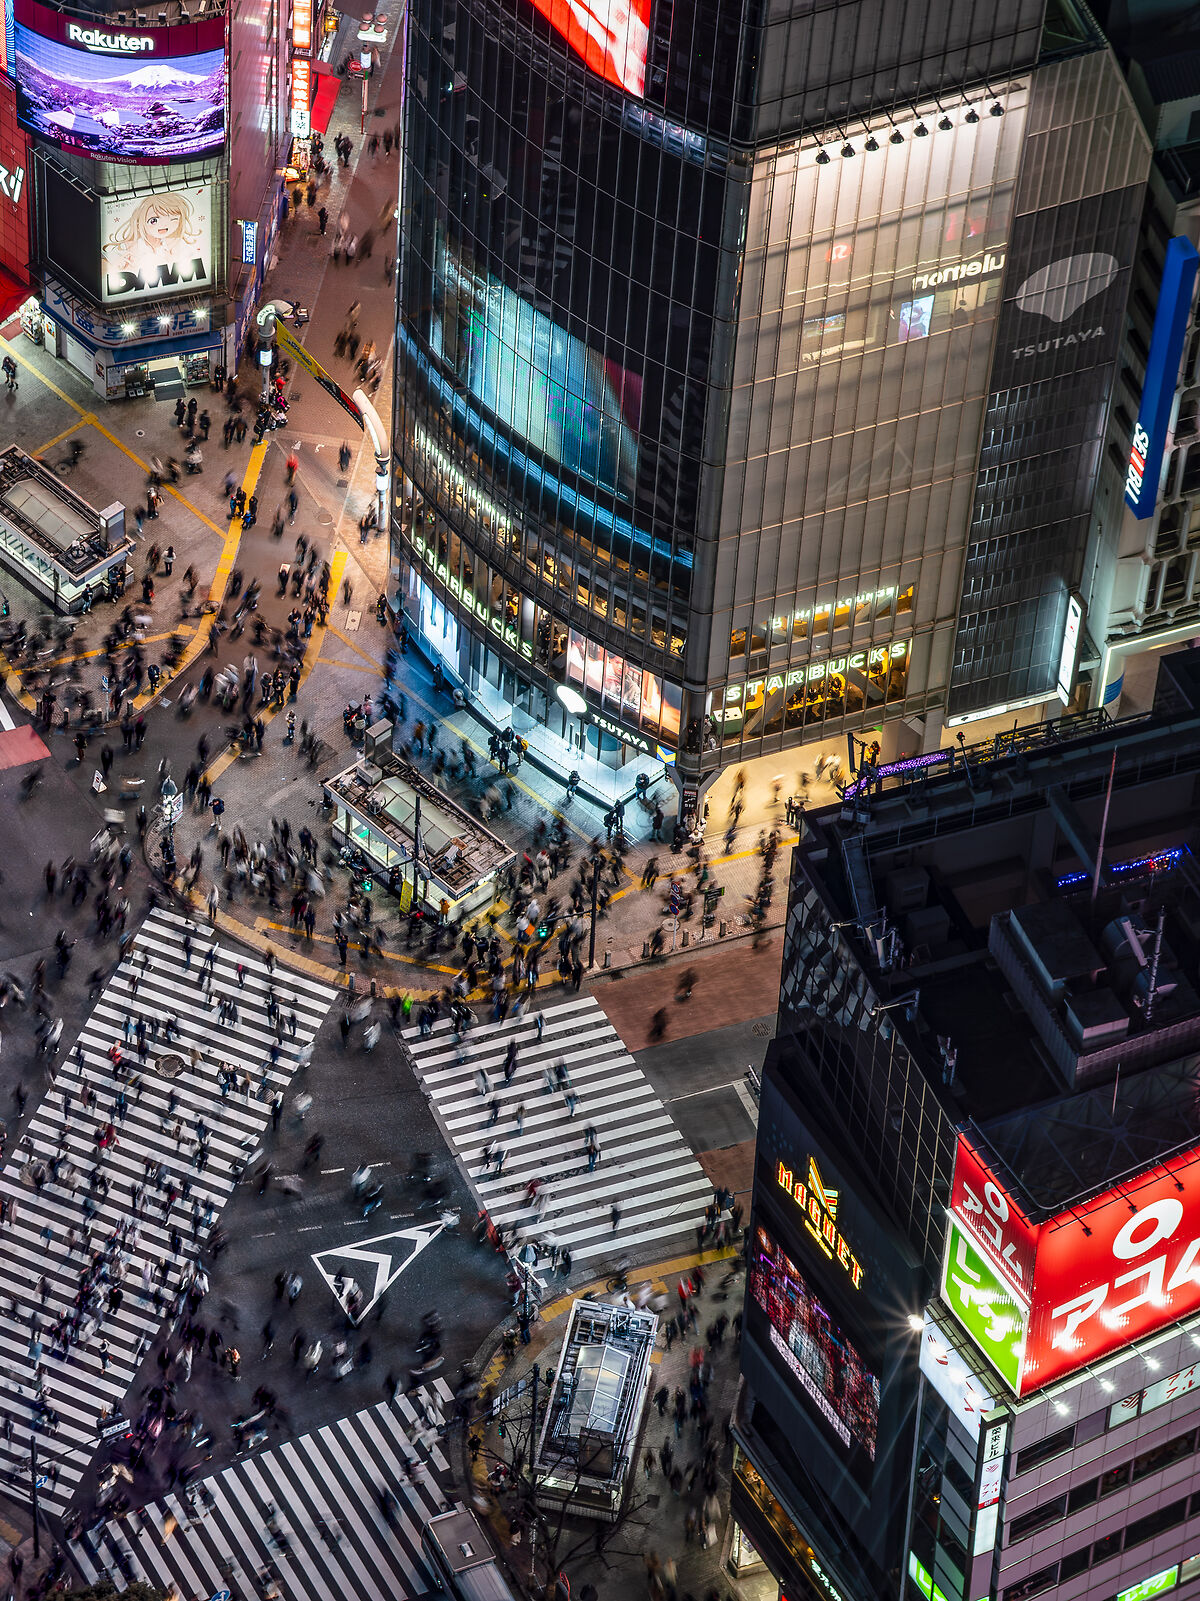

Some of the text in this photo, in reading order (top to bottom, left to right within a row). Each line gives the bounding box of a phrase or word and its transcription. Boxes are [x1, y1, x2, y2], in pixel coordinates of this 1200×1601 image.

[69, 23, 154, 52] Rakuten
[90, 152, 138, 164] Rakuten Vision
[1011, 326, 1106, 360] TSUTAYA
[415, 536, 533, 658] STARBUCKS
[726, 641, 906, 701] STARBUCKS
[592, 713, 649, 751] TSUTAYA
[778, 1161, 863, 1290] MAGNET
[963, 1181, 1024, 1281] アコム
